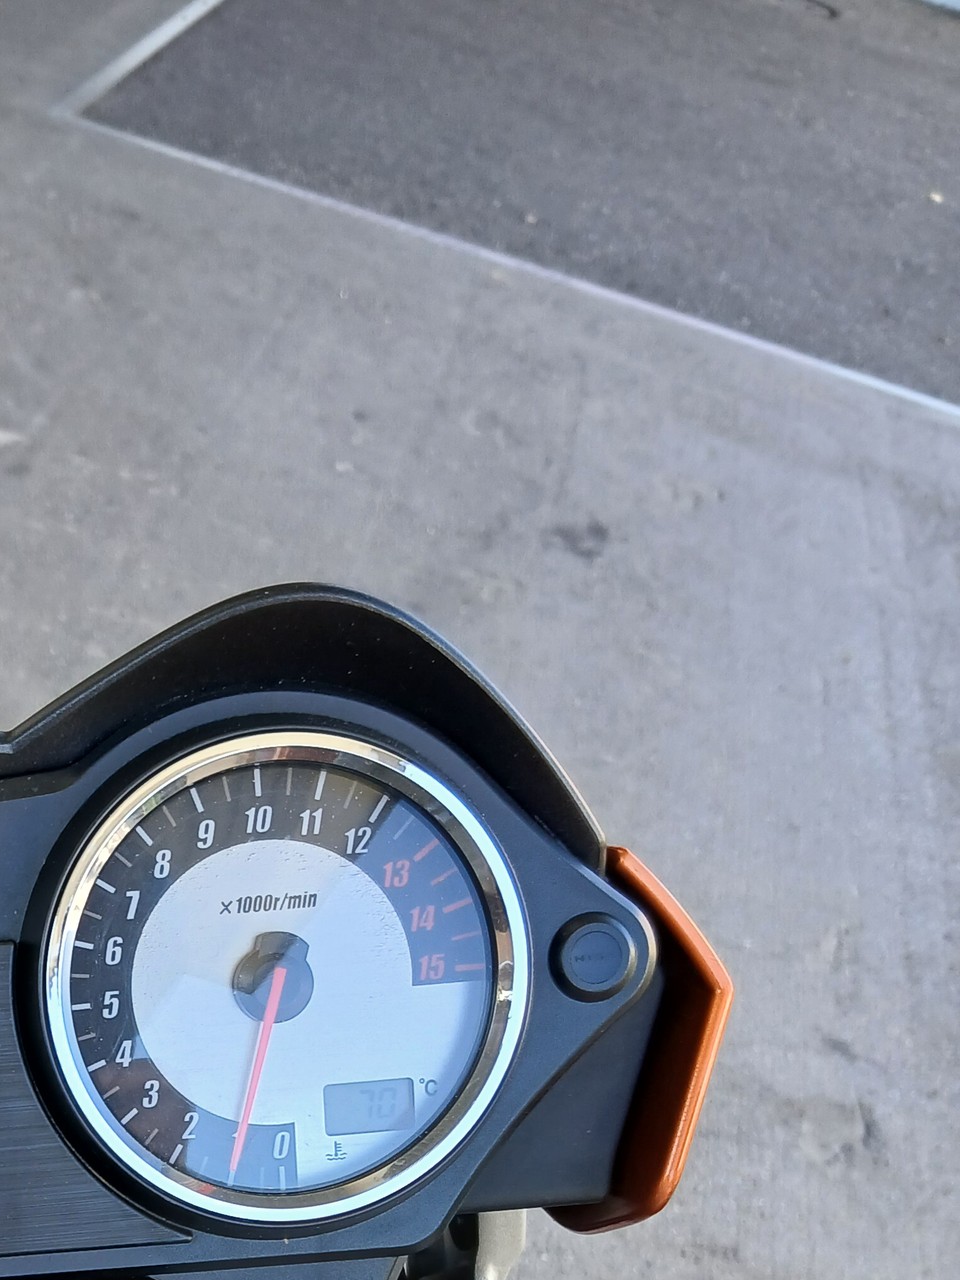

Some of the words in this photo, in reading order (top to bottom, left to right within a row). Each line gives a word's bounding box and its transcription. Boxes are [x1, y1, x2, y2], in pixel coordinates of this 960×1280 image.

[196, 819, 215, 850] 9
[244, 806, 273, 834] 10
[299, 807, 323, 837] 11
[344, 826, 372, 856] 12
[153, 849, 171, 879] 8
[382, 858, 411, 889] 13
[125, 890, 141, 921] 7
[409, 904, 435, 932] 14
[104, 936, 123, 966] 6
[418, 953, 445, 981] 15
[102, 990, 120, 1020] 5
[115, 1040, 133, 1067] 4
[142, 1079, 159, 1108] 3
[181, 1111, 200, 1140] 2
[272, 1131, 291, 1160] 0
